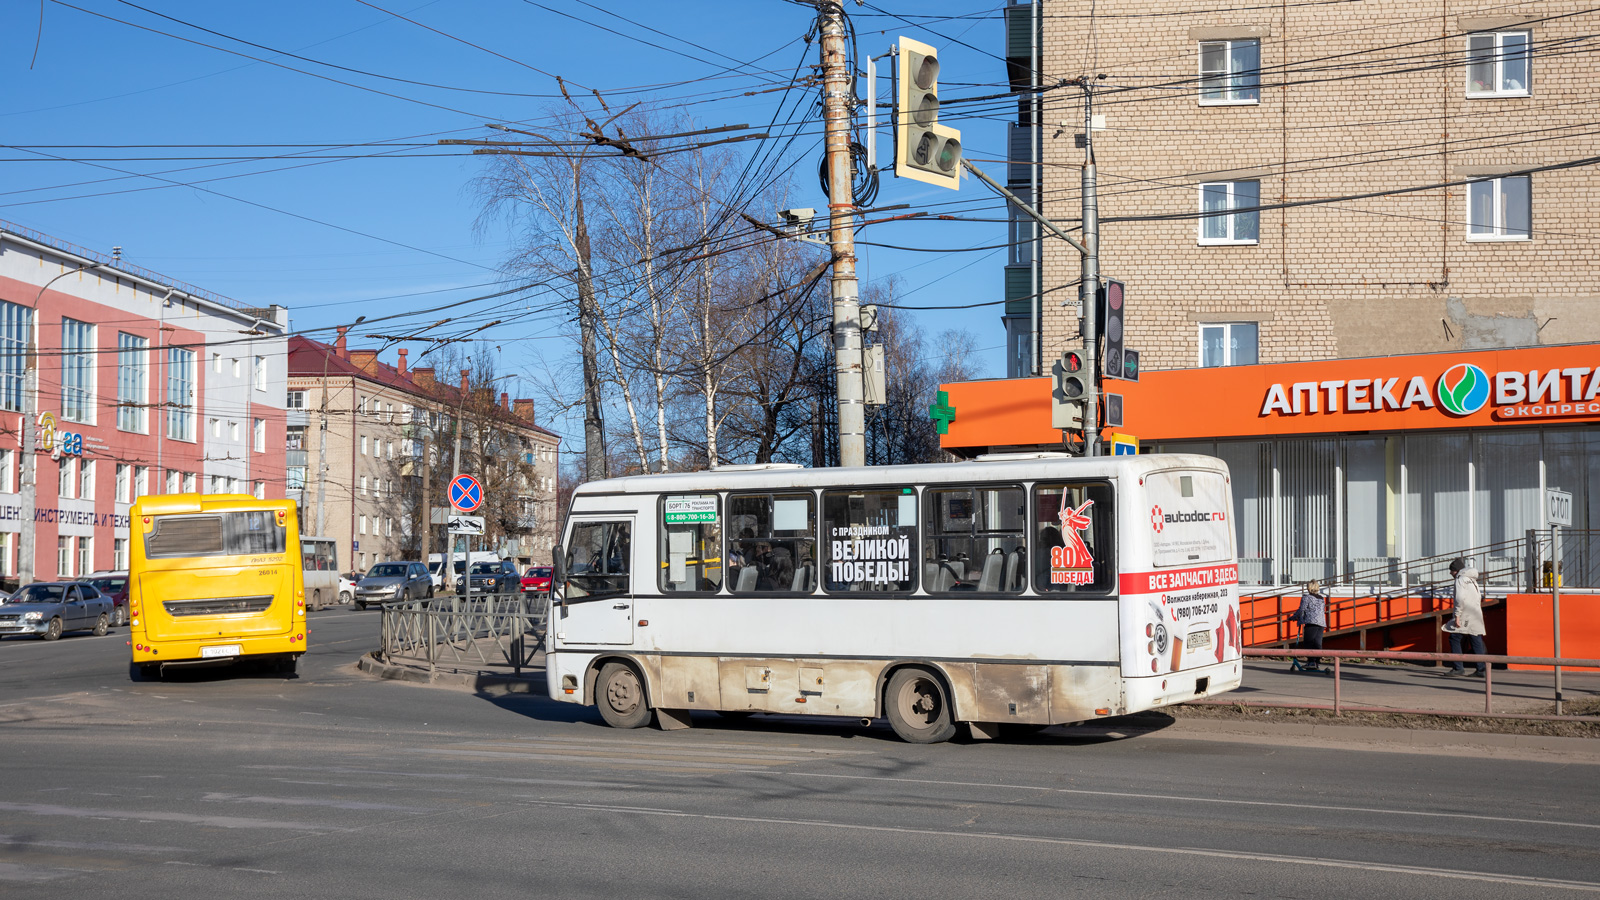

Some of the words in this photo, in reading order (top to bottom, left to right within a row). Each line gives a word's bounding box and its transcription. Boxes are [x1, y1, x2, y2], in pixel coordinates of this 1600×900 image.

[1261, 376, 1435, 415] АПТЕКА
[1164, 510, 1225, 523] autodoc.ru
[1550, 496, 1569, 519] СТОП
[34, 508, 99, 526] ИНСТРУМЕНТА
[101, 514, 108, 527] И
[249, 518, 260, 530] 12
[670, 513, 715, 521] 8-800-700-16-36
[832, 527, 838, 536] С
[838, 526, 889, 537] ПРАЗДНИКОМ
[832, 535, 909, 560] ВЕЛИКОЙ
[1051, 546, 1074, 568] 80
[832, 561, 909, 585] ПОБЕДЫ!
[1051, 571, 1093, 585] ПОБЕДА!
[1148, 575, 1167, 590] ВСЕ
[1169, 571, 1213, 588] ЗАПЧАСТИ
[1214, 568, 1238, 586] ЗДЕСЬ
[1167, 595, 1191, 604] Волжская
[1191, 592, 1219, 603] набережная,
[1220, 589, 1228, 597] 203
[1176, 606, 1191, 621] (980)
[1191, 604, 1218, 616] 706-27-00
